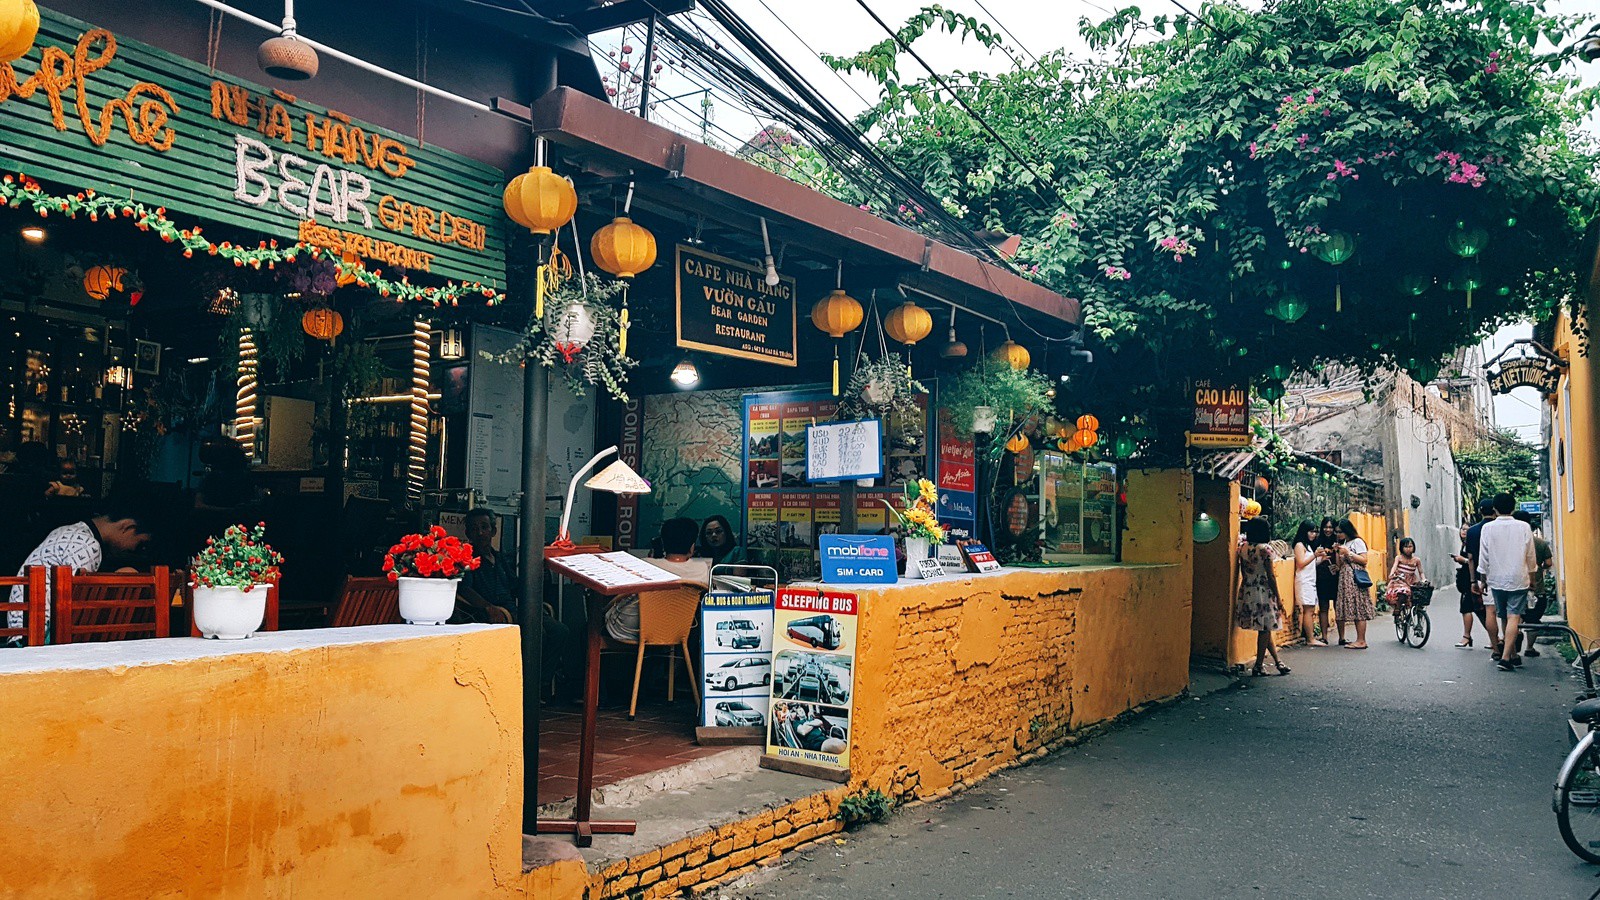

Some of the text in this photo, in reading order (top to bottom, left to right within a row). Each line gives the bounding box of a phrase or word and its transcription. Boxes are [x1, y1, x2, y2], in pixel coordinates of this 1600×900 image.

[234, 133, 486, 252] BEAR GARDEN
[684, 258, 722, 281] CAFE
[725, 271, 753, 290] NHÀ
[711, 304, 768, 328] BEAR GARDEN
[715, 323, 766, 343] RESTAURANT
[1195, 383, 1244, 406] CAO LẦU
[827, 544, 889, 557] mobifone
[859, 568, 884, 577] CARD
[716, 596, 726, 605] BUS
[726, 596, 731, 605] &
[731, 595, 744, 605] BOAT
[744, 594, 771, 605] TRANSPORT
[781, 594, 853, 612] SLEEPING BUS
[790, 750, 800, 758] AN
[804, 752, 818, 760] NHA
[819, 754, 839, 764] TRANG
